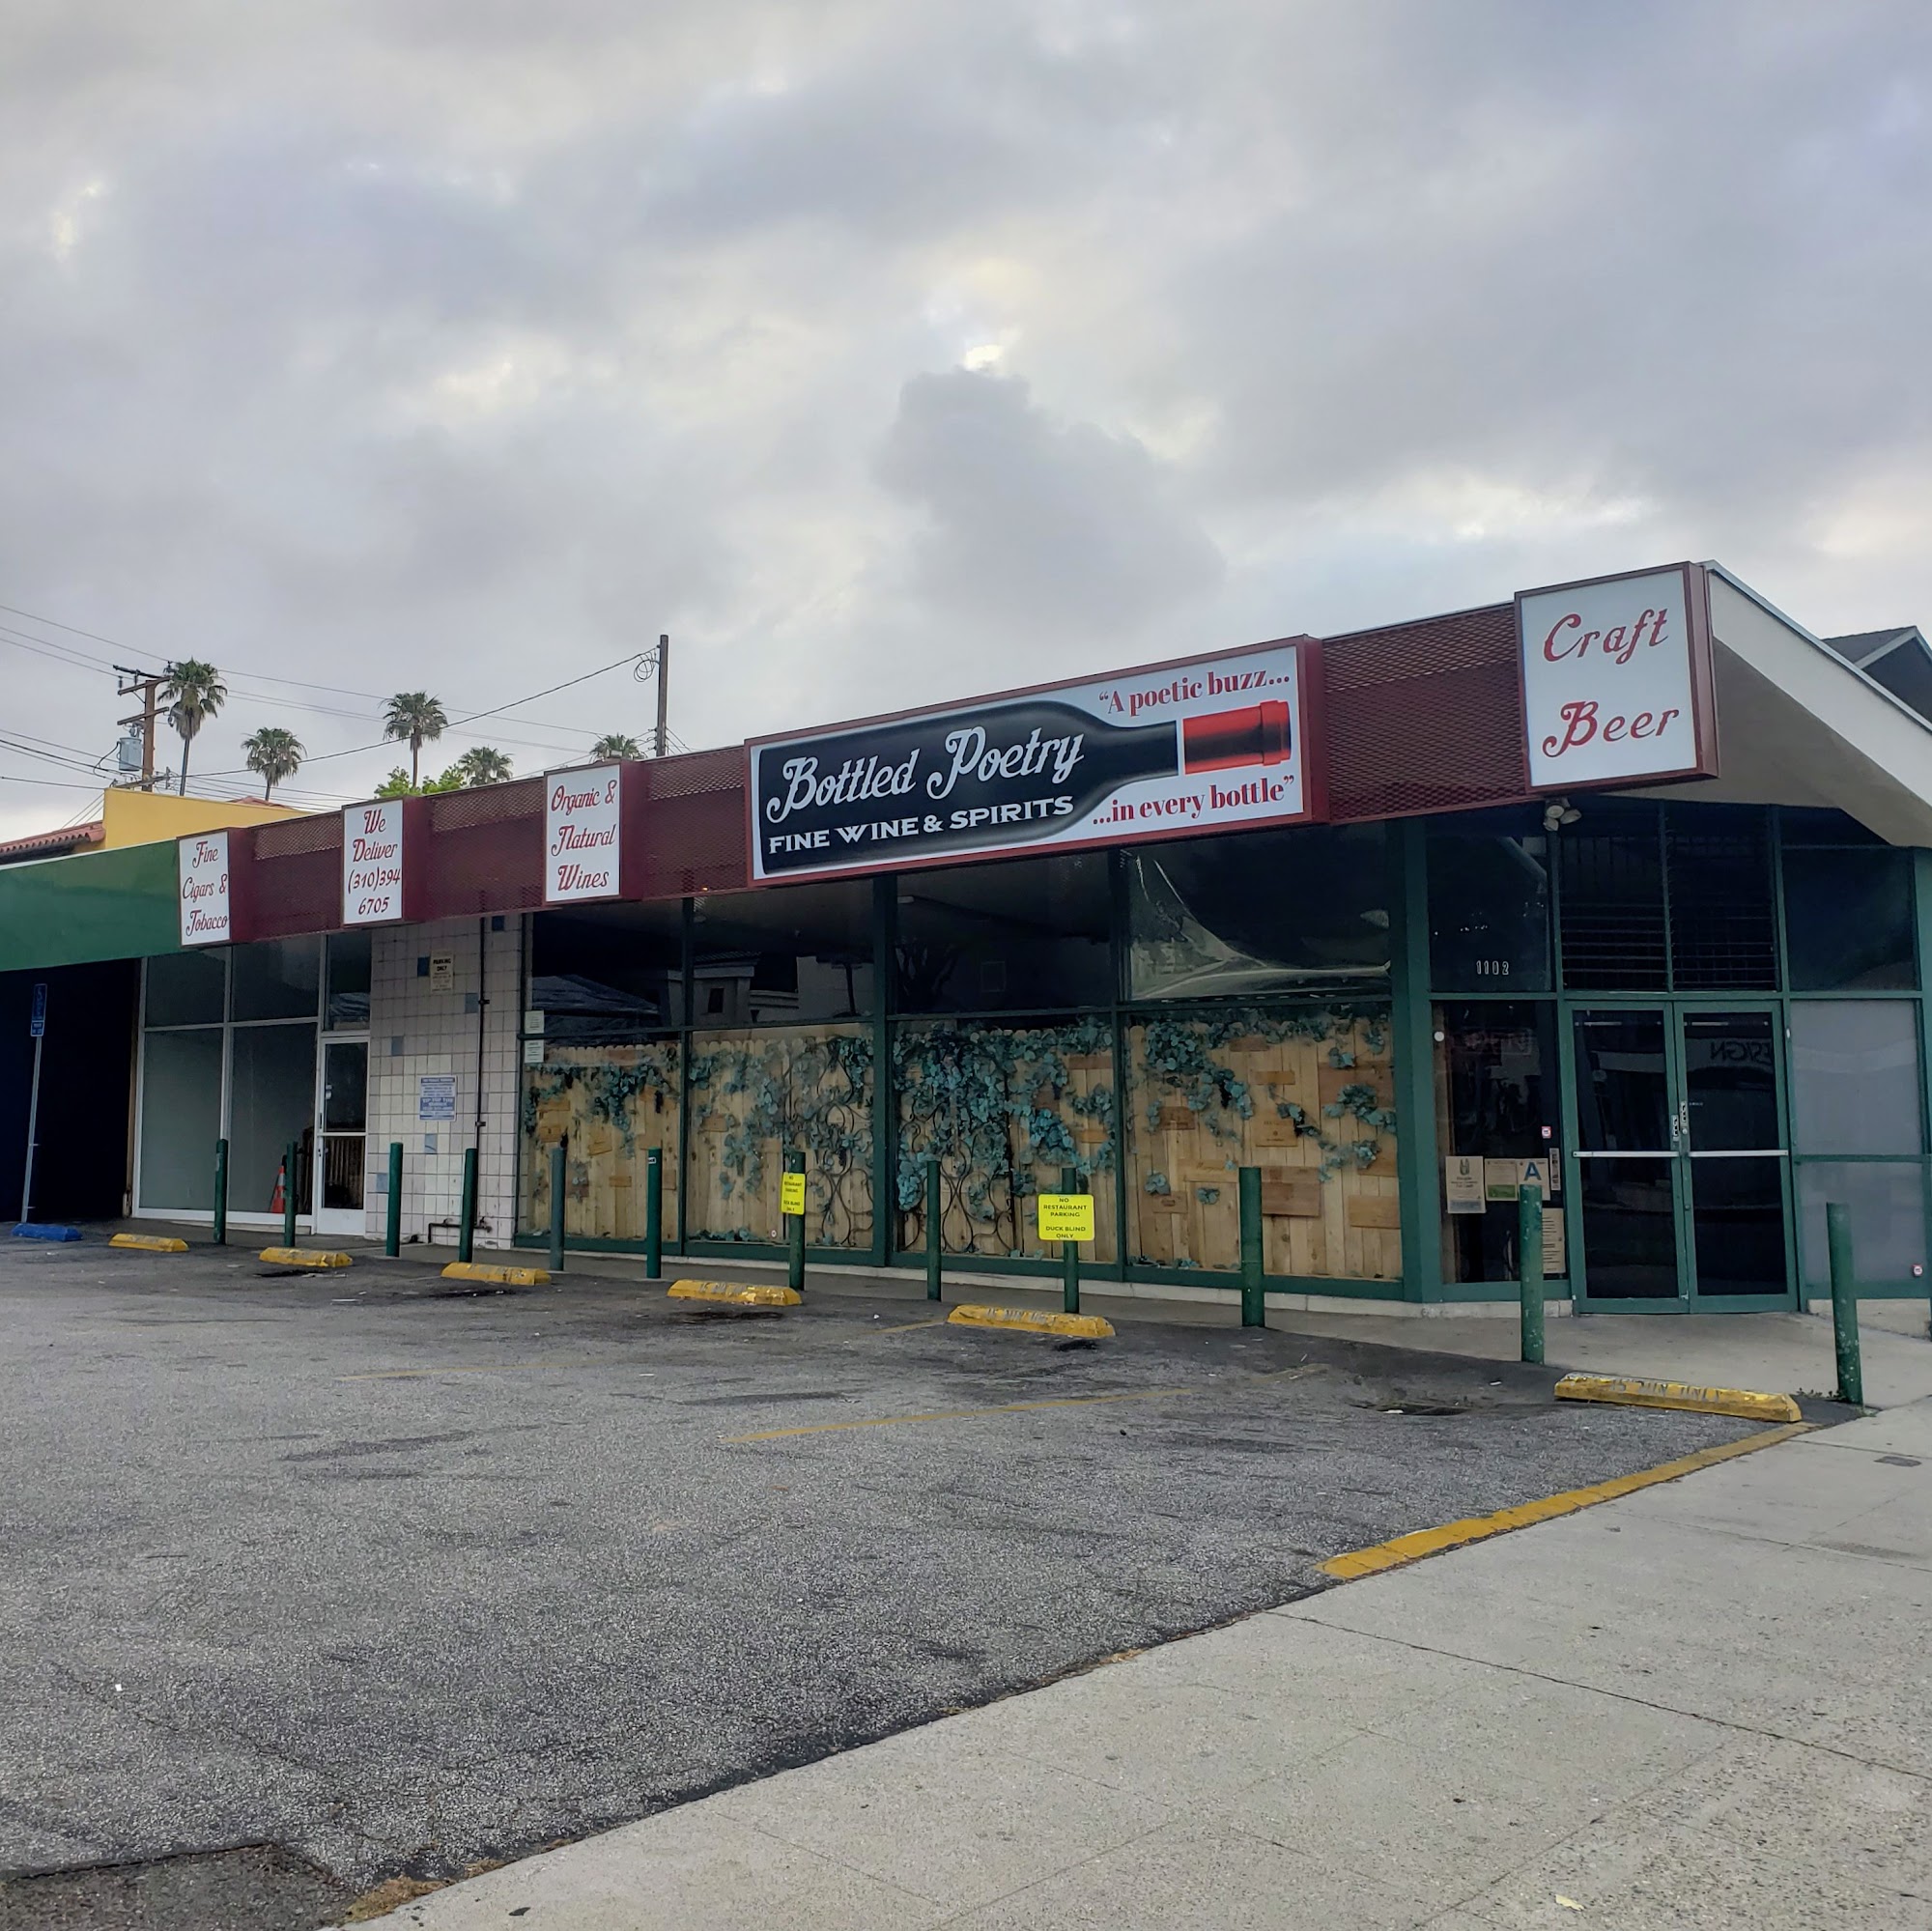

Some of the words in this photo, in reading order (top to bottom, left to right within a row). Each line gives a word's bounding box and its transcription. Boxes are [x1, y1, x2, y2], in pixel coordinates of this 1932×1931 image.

[1544, 608, 1669, 665] Craft
[1128, 677, 1203, 718] poetic
[1207, 669, 1290, 696] buzz...
[1542, 700, 1680, 758] Beer
[766, 748, 921, 824] Bottled
[926, 725, 1085, 800] Poetry
[551, 784, 601, 816] Organic
[604, 779, 617, 805] &
[1093, 799, 1136, 825] ...in
[1139, 793, 1207, 819] every
[1209, 775, 1294, 809] bottle”
[363, 809, 387, 835] We
[768, 829, 831, 855] FINE
[834, 816, 920, 844] WINE
[923, 814, 945, 834] &
[949, 795, 1074, 830] SPIRITS
[191, 840, 219, 868] Fine
[352, 838, 398, 863] Deliver
[551, 823, 617, 857] Natural
[183, 876, 215, 903] Cigars
[218, 873, 228, 895] &
[348, 866, 401, 895] (310)394
[557, 864, 610, 892] Wines
[357, 896, 390, 916] 6705
[185, 909, 229, 937] Tobacco
[1476, 960, 1509, 976] 1102
[1523, 1161, 1543, 1181] A
